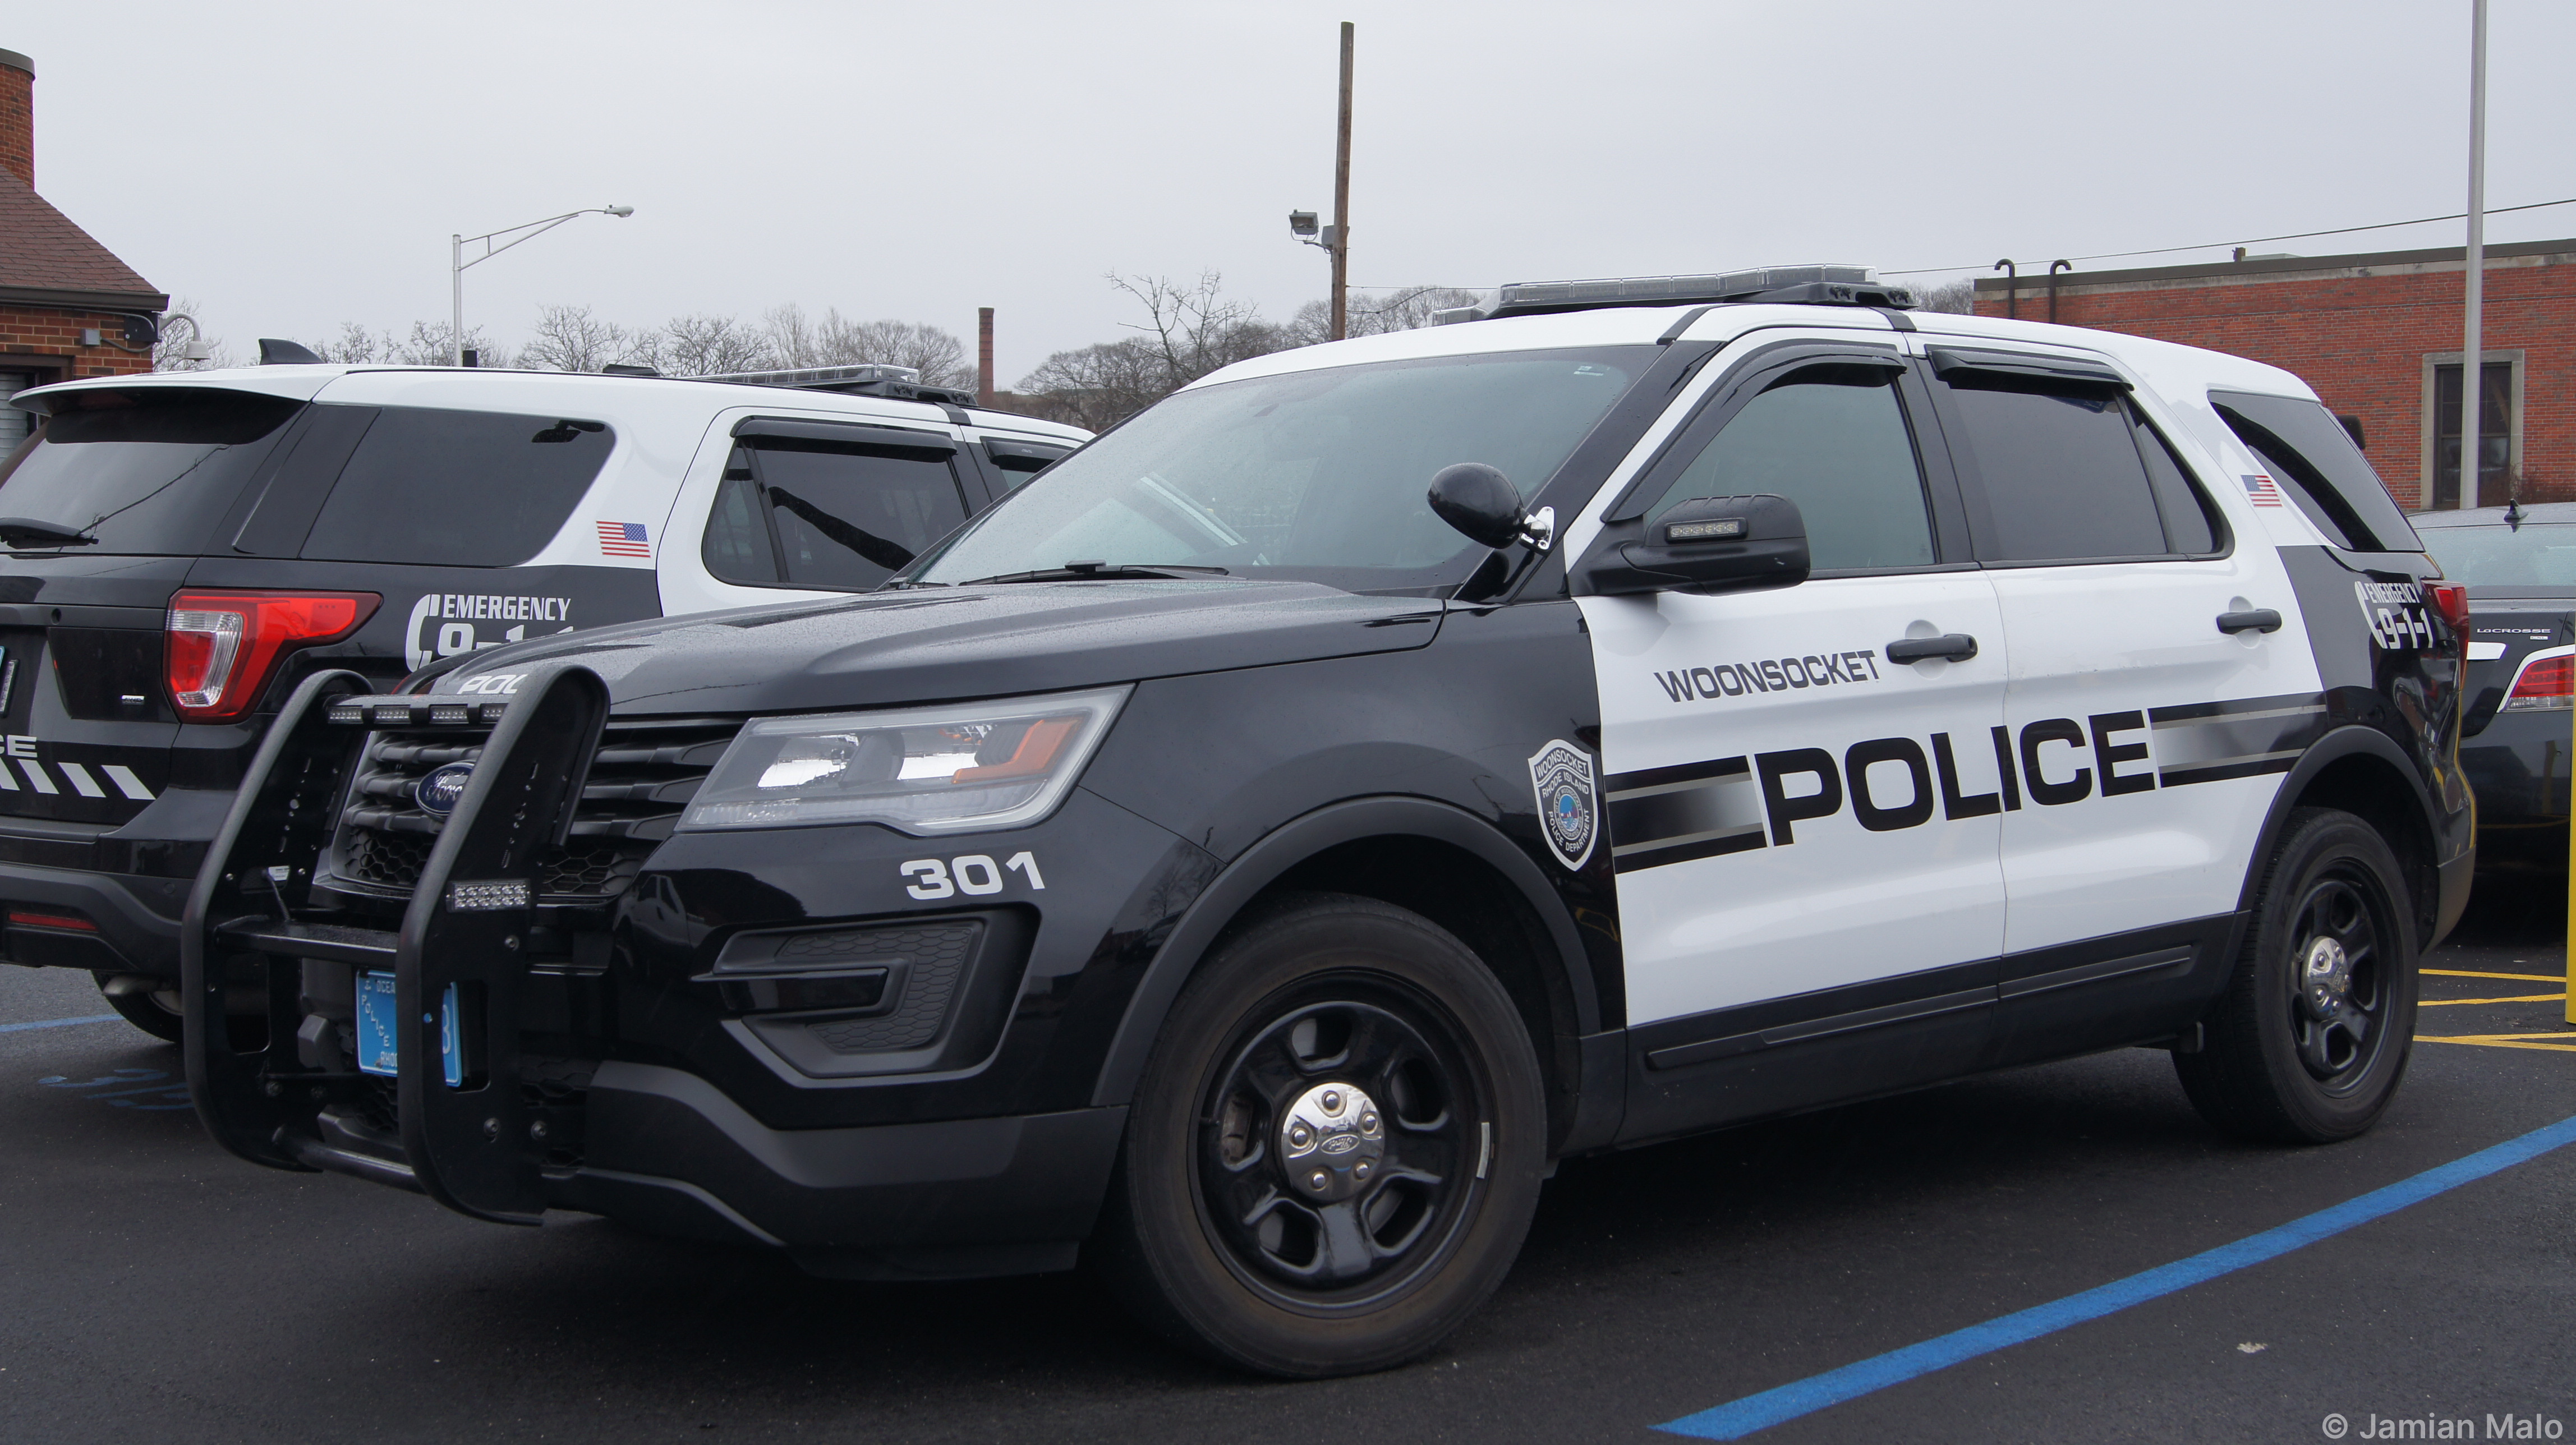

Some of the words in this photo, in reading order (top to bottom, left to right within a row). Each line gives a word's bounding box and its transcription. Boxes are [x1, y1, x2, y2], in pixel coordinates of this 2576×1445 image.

[442, 593, 572, 621] EMERGENCY
[2364, 582, 2420, 603] EMERGENCY
[2377, 608, 2433, 649] 9-1-1
[1653, 650, 1880, 703] WOONSOCKET
[1535, 749, 1587, 779] WOONSOCKET
[1542, 772, 1563, 799] RHODE
[1563, 771, 1589, 795] ISLAND
[1754, 709, 2156, 847] POLICE
[1548, 811, 1564, 846] POLICE
[1565, 808, 1590, 853] DEPARTMENT
[900, 851, 1045, 900] 301
[361, 995, 390, 1047] POLICE
